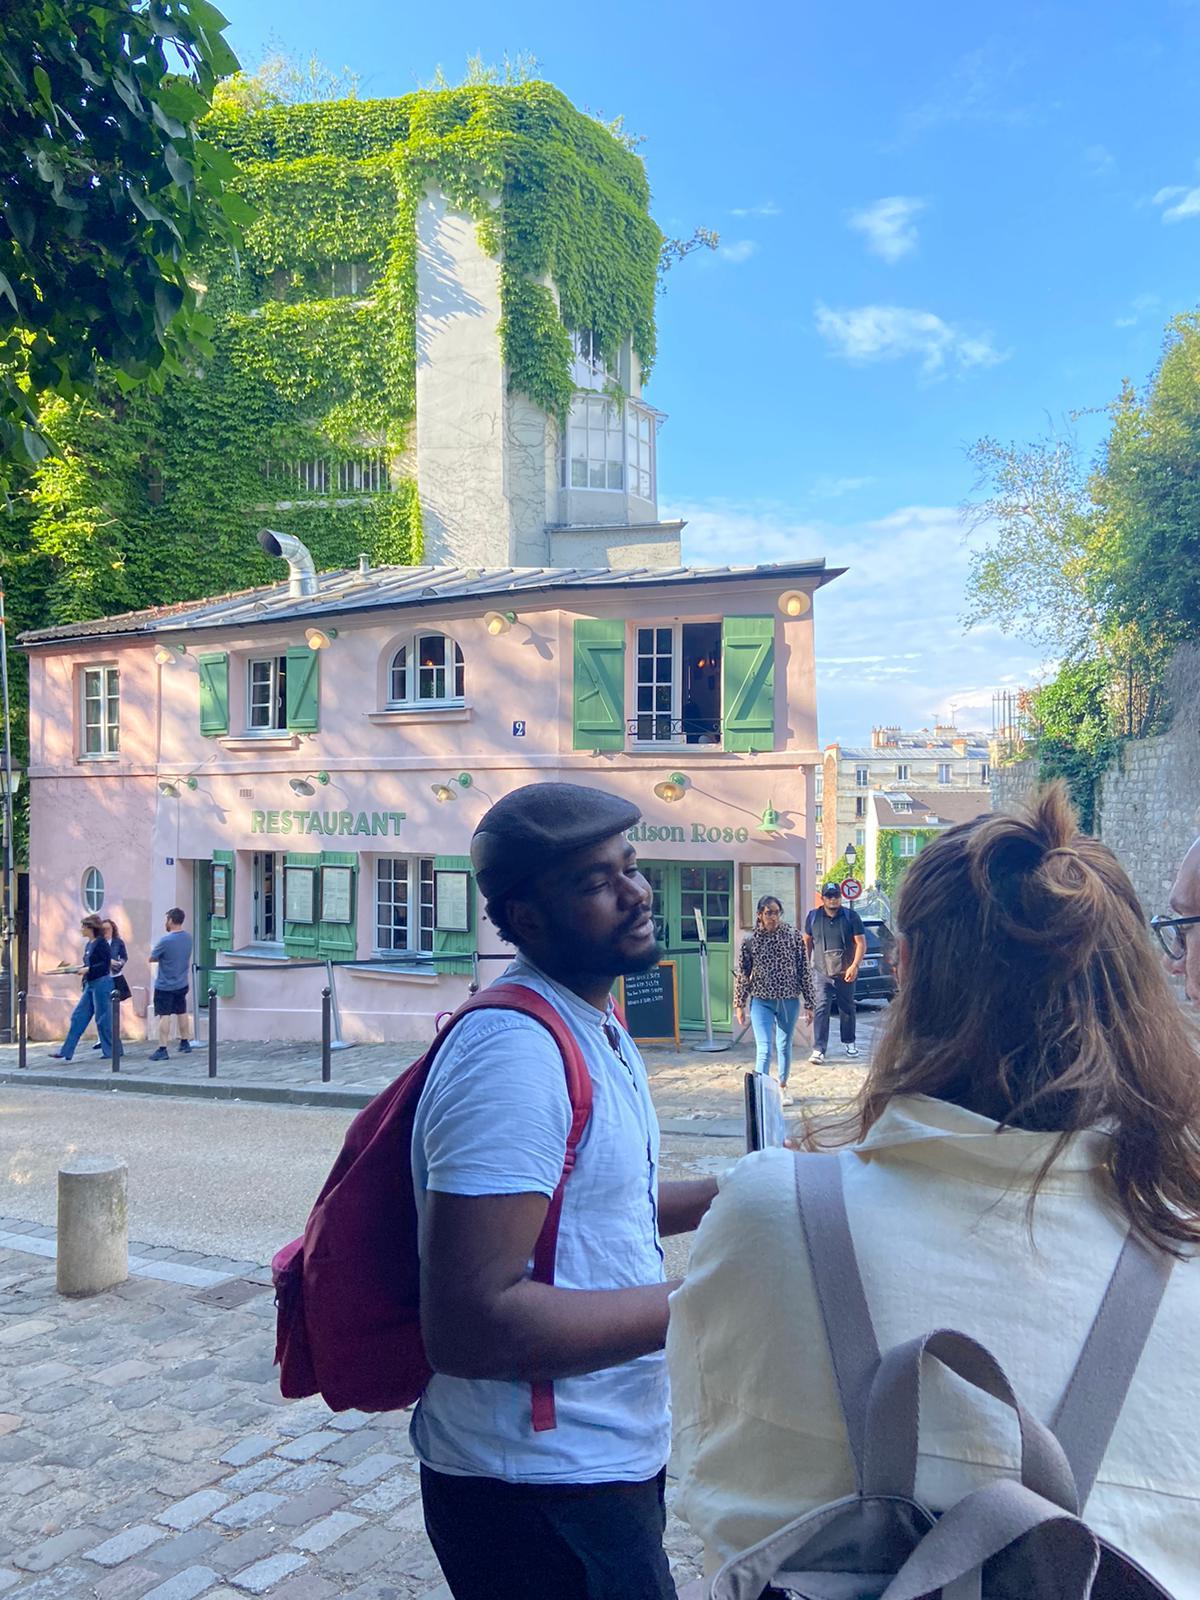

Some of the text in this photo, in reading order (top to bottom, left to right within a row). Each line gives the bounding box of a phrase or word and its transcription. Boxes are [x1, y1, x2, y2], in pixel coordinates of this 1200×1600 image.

[515, 721, 523, 735] 2
[251, 810, 406, 836] RESTAURANT
[626, 822, 749, 843] aison Rose
